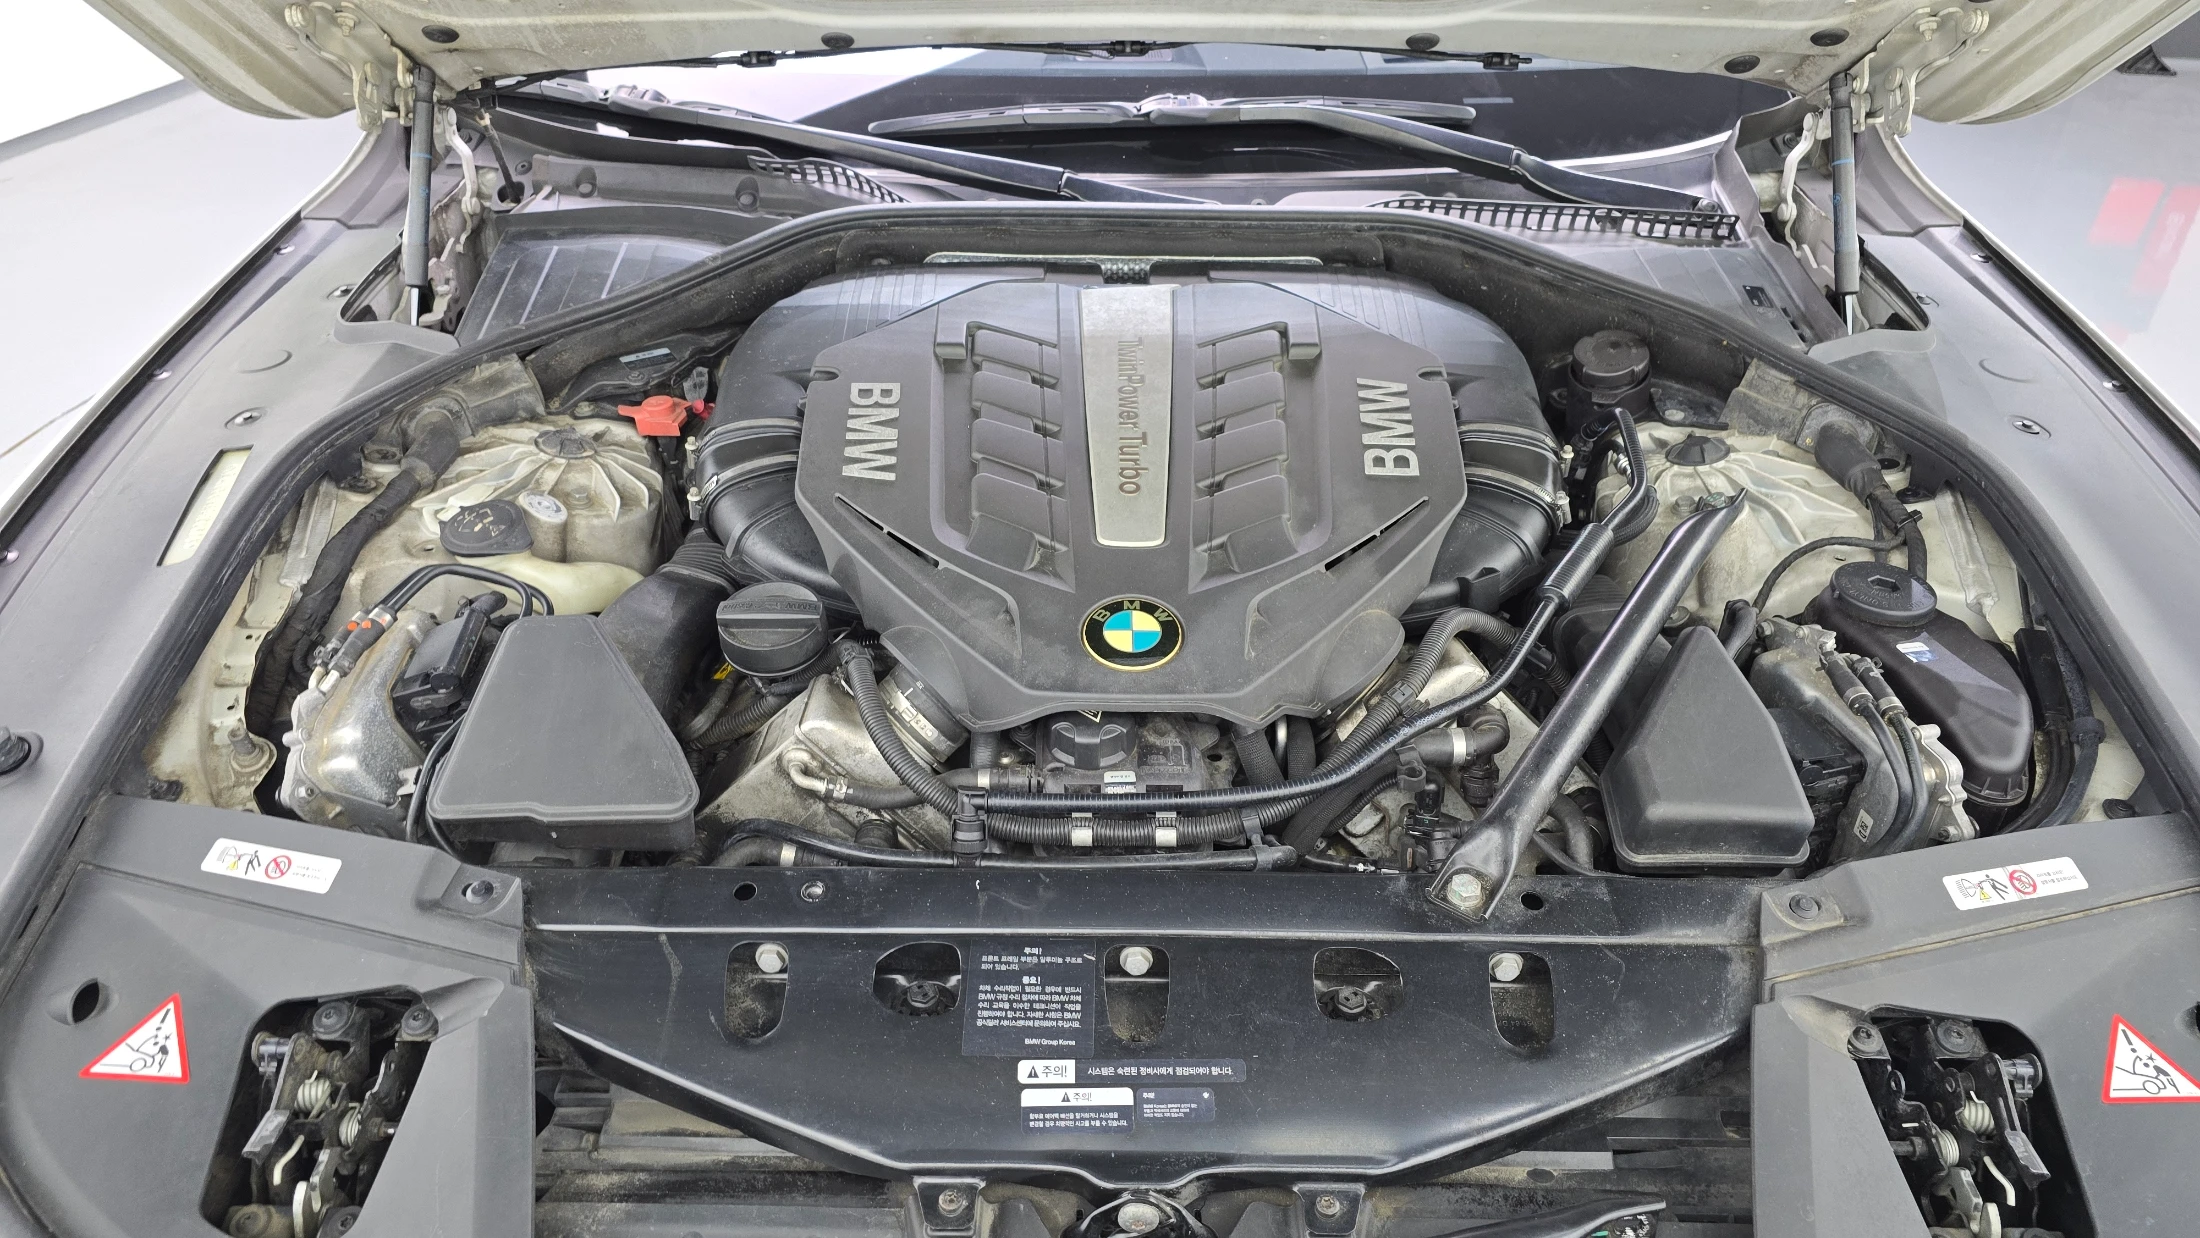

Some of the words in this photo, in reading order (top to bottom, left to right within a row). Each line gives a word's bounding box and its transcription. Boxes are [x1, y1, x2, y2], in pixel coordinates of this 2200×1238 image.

[1118, 337, 1145, 431] TwinPower
[842, 382, 900, 480] BMW
[1357, 378, 1419, 476] BMW
[1119, 431, 1149, 496] Turbo
[785, 602, 817, 611] BMW
[1093, 600, 1173, 622] BMW
[1024, 947, 1042, 955] 주의!
[1022, 976, 1040, 984] 중요!
[1065, 986, 1082, 994] 반드시
[1009, 993, 1020, 1001] 수리
[1041, 1038, 1058, 1046] Group
[1042, 1065, 1067, 1078] 주의!
[1088, 1067, 1115, 1075] 시스템은
[1117, 1067, 1138, 1075] 숙련된
[1139, 1067, 1174, 1075] 정비사에게
[1175, 1067, 1210, 1075] 점검되어야
[1211, 1067, 1234, 1075] 합니다.
[1073, 1092, 1092, 1102] 주의!
